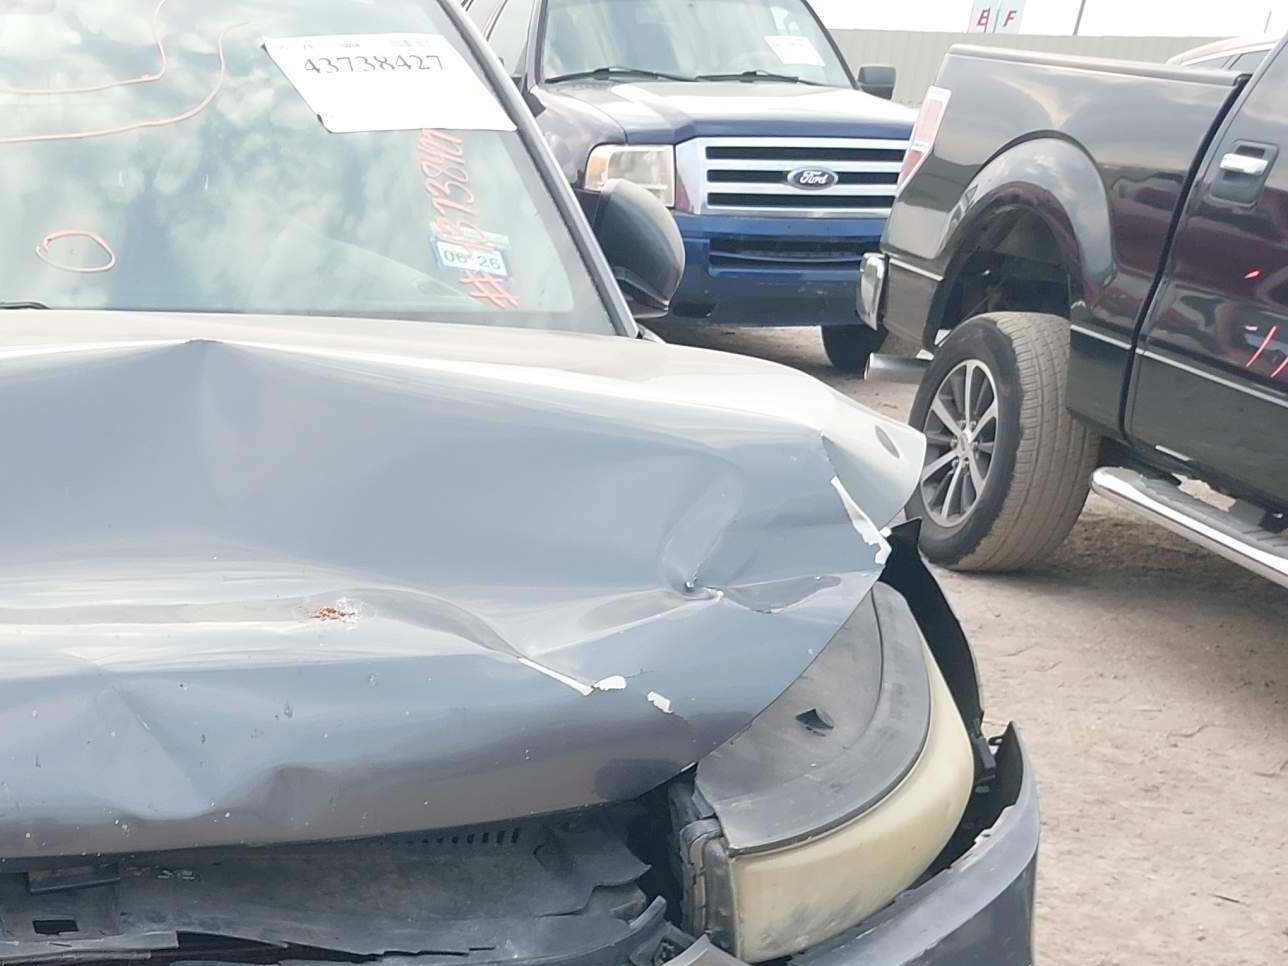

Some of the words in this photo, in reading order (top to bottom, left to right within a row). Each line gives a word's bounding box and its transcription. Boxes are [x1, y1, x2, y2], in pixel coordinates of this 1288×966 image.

[975, 8, 990, 27] E
[1003, 10, 1017, 27] F
[303, 54, 445, 74] 43738427
